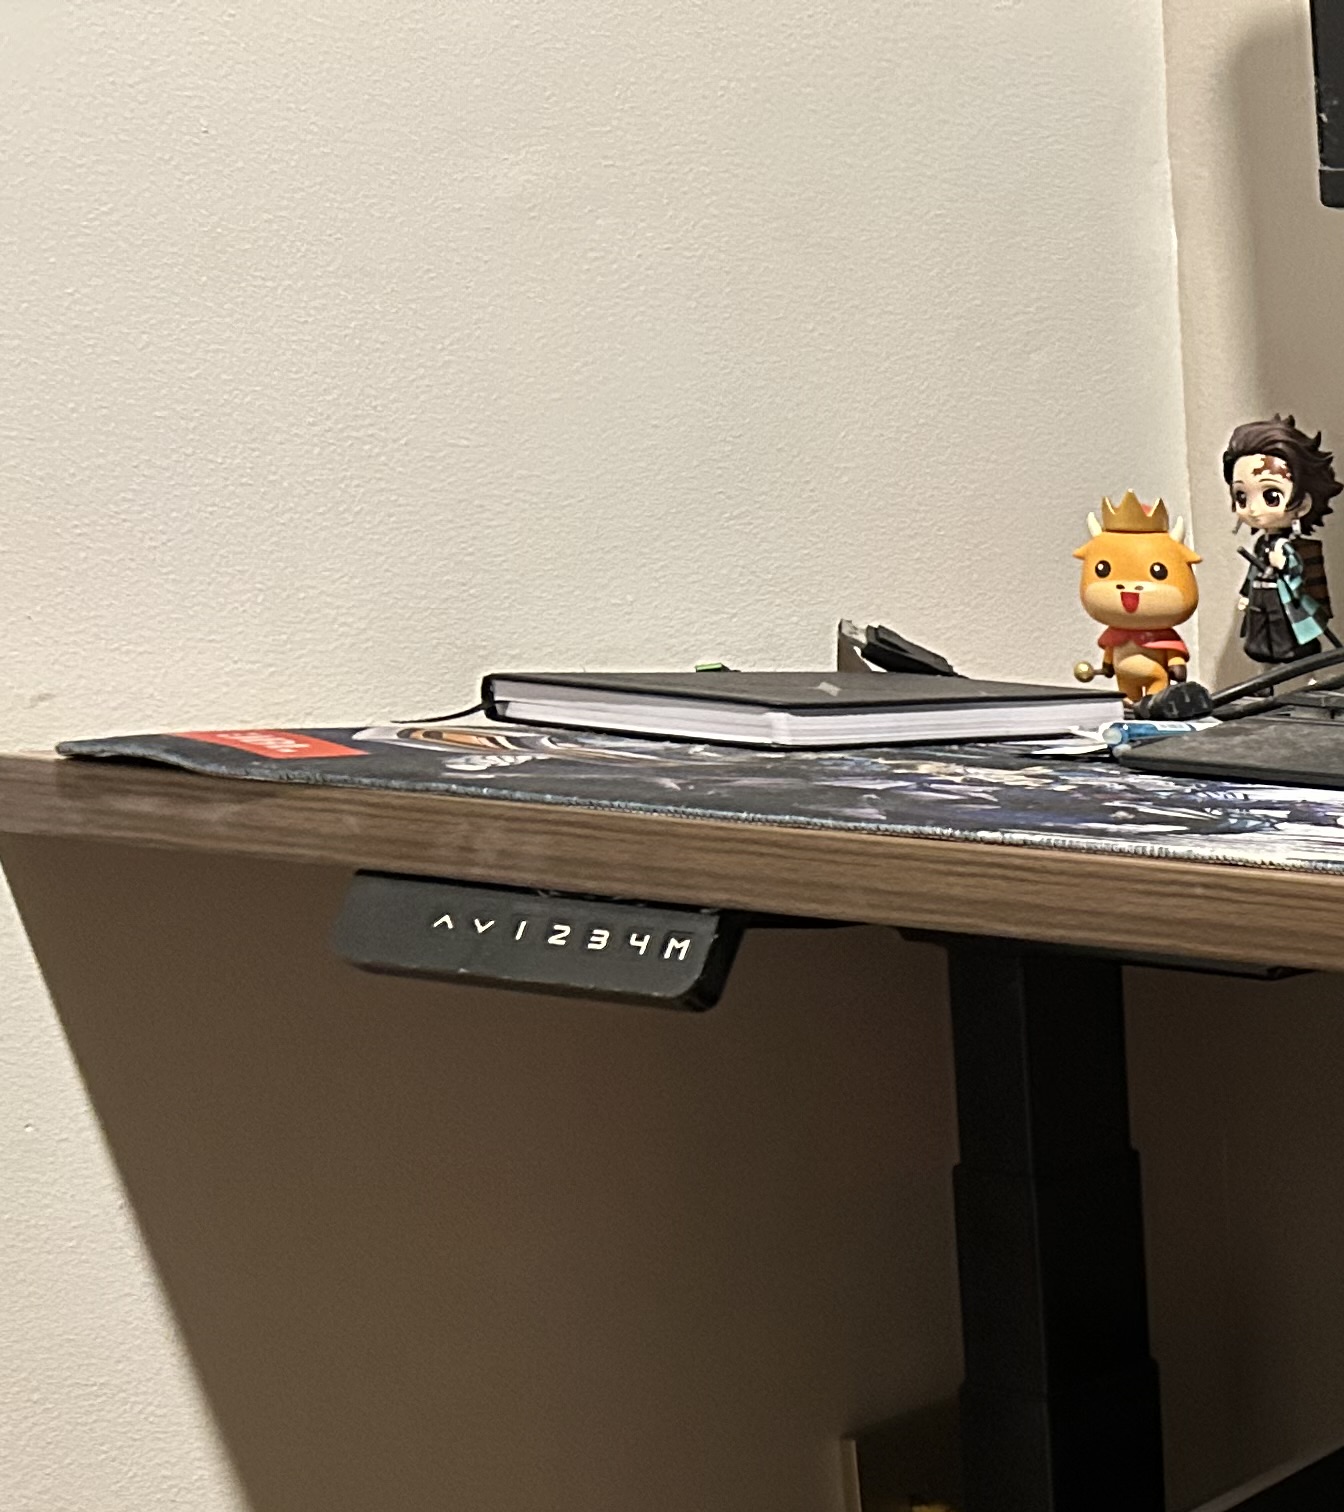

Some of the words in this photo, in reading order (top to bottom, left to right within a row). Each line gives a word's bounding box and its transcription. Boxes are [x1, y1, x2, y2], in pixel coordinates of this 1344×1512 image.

[547, 924, 571, 946] 2
[587, 929, 610, 951] 3
[629, 934, 650, 955] 4
